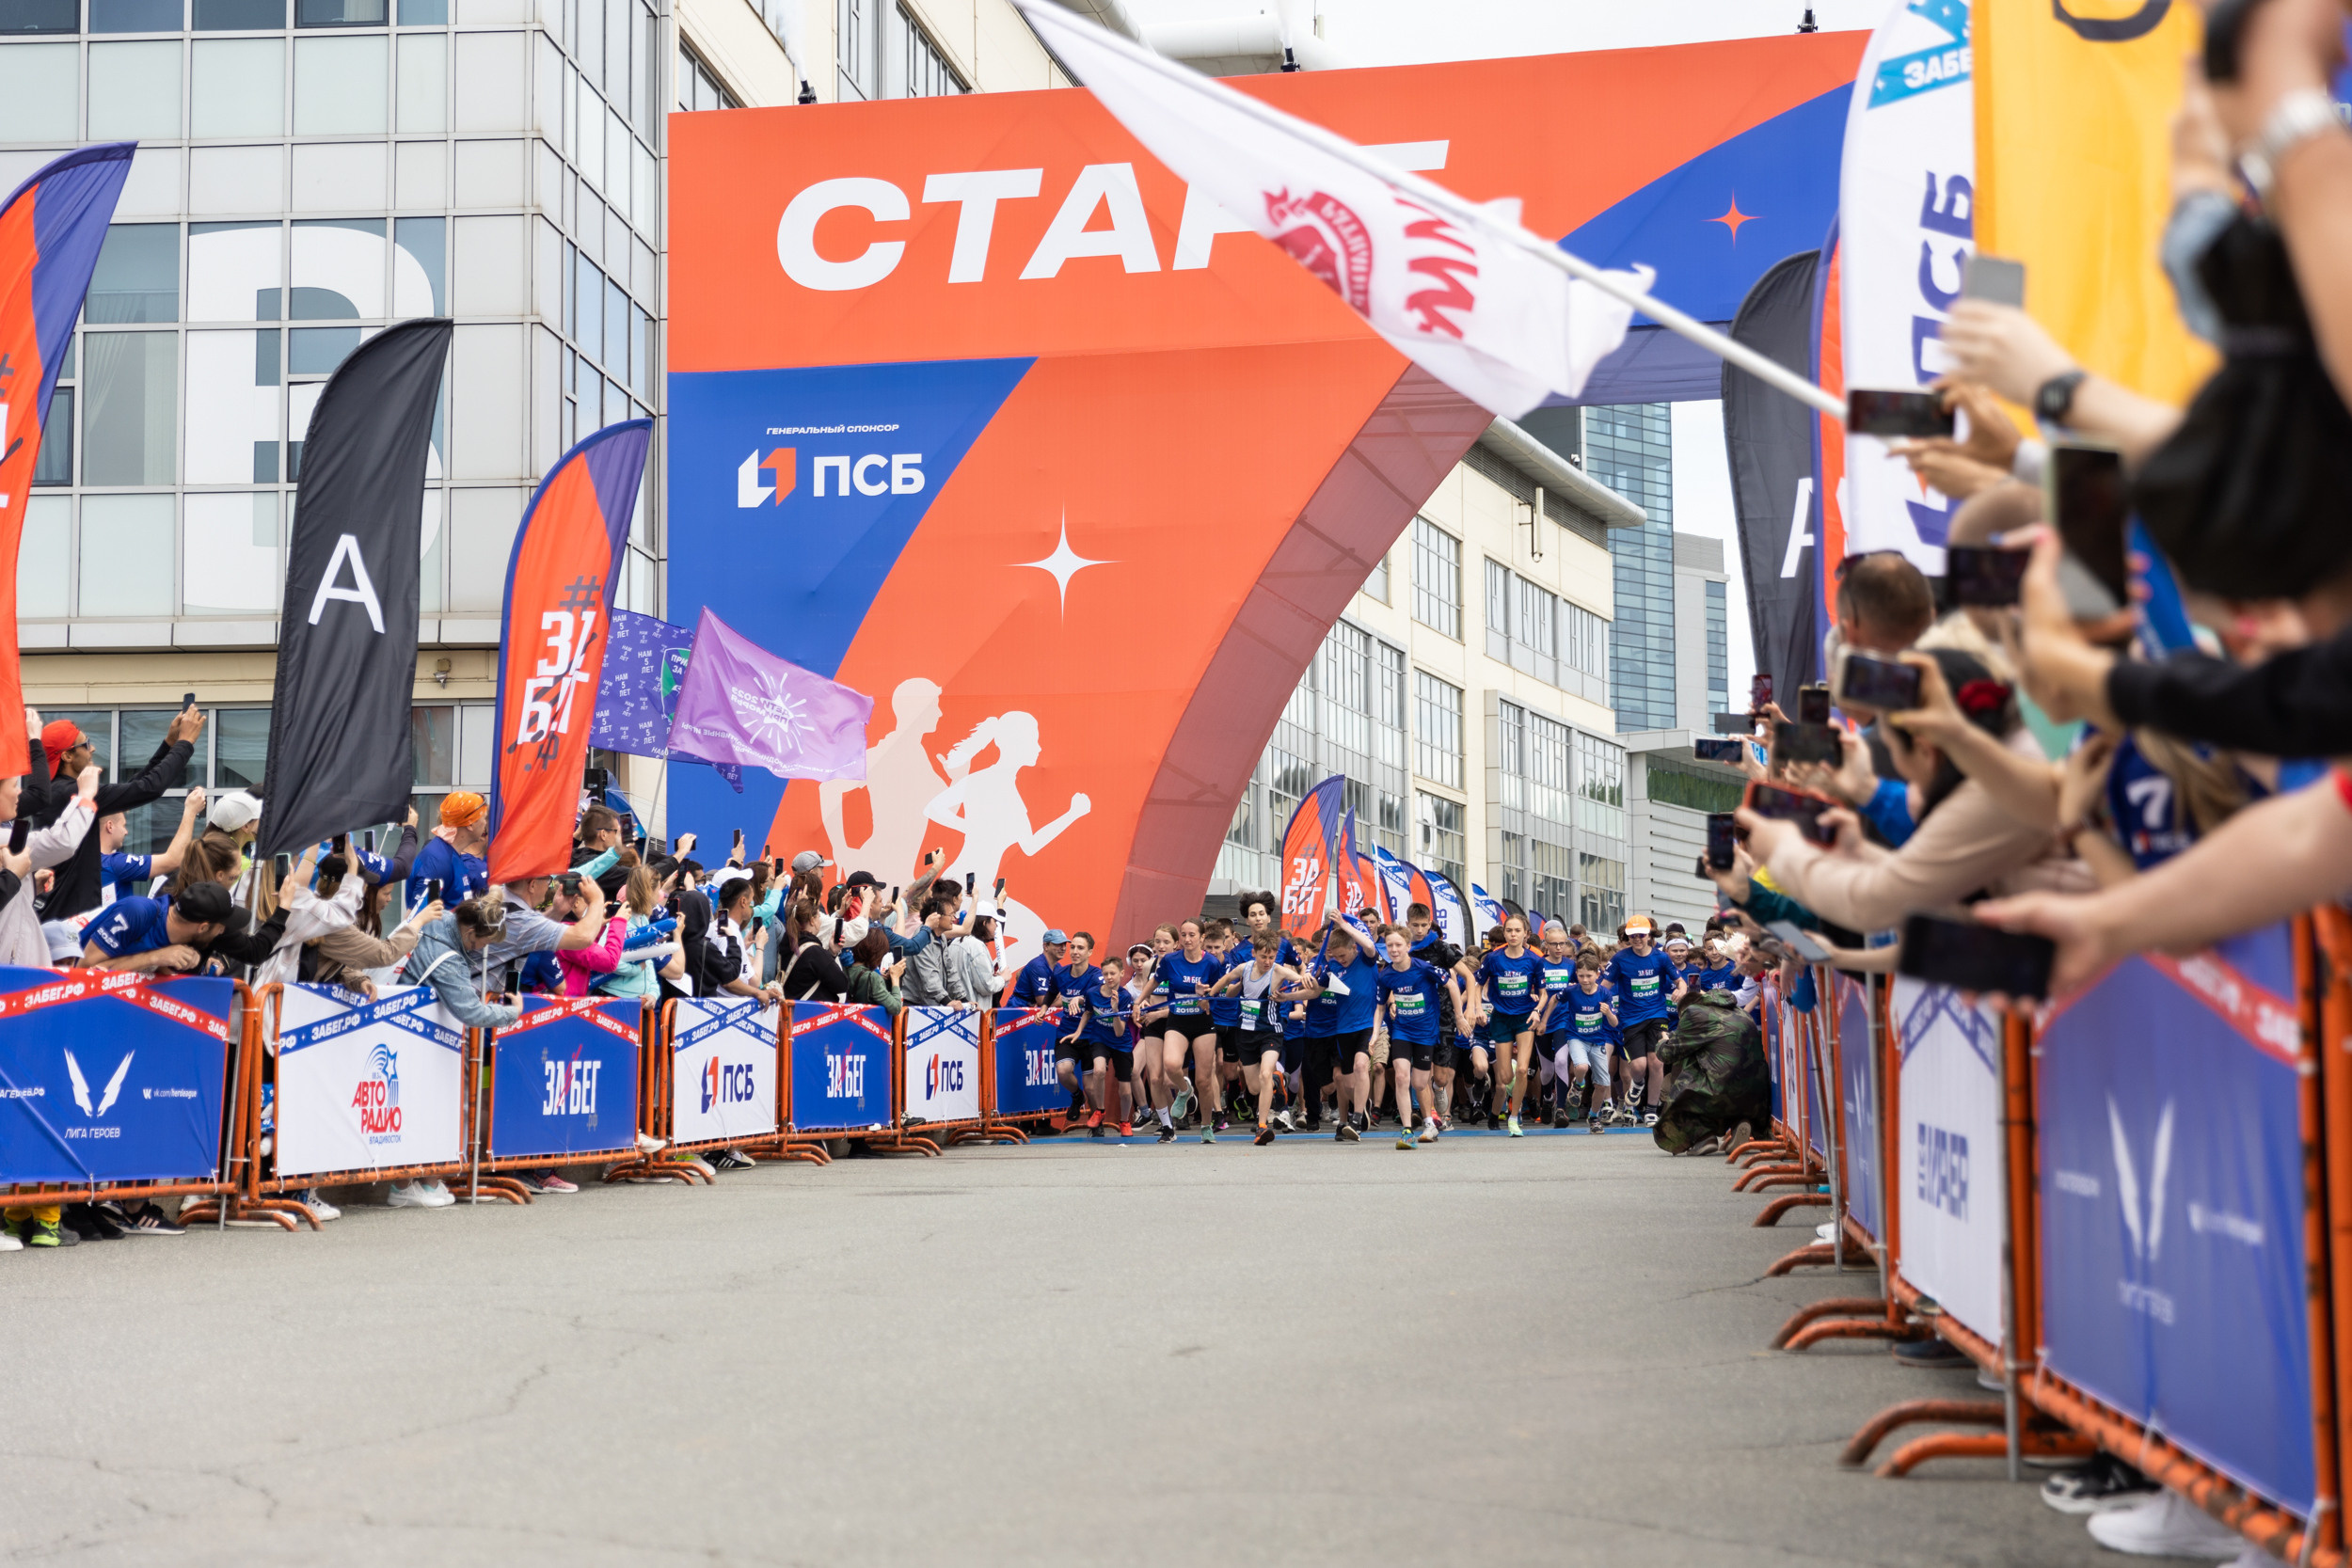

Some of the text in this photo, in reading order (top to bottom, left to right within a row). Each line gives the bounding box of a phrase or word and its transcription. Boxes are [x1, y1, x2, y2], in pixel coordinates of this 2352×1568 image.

[766, 424, 899, 436] ГЕНЕРАЛЬНЫЙ СПОНСОР
[813, 453, 926, 497] ПСБ
[2126, 775, 2171, 828] 7
[110, 912, 129, 935] 7
[97, 927, 119, 949] 2023
[24, 982, 85, 1008] ЗАБЕГ.РФ
[102, 971, 156, 990] ЗАБЕГ.РФ
[1038, 977, 1046, 987] 7
[1632, 990, 1659, 998] 20404
[150, 995, 197, 1023] ЗАБЕГ.РФ
[311, 1014, 360, 1040] ЗАБЕГ.РФ
[373, 993, 419, 1020] ЗАБЕГ.РФ
[532, 1006, 564, 1024] ЗАБЕГ.РФ
[691, 1020, 720, 1042] ЗАБЕГ.РФ
[725, 1004, 752, 1024] ЗАБЕГ.РФ
[596, 1014, 623, 1034] ЗАБЕГ.РФ
[542, 1060, 602, 1116] ЗАБЕГ
[723, 1063, 755, 1103] ПСБ
[826, 1054, 866, 1099] ЗАБЕГ
[941, 1060, 963, 1092] ПСБ
[351, 1081, 386, 1108] АВТО
[65, 1128, 120, 1139] ЛИГА ГЕРОЕВ
[361, 1106, 403, 1134] РАДИО
[369, 1133, 402, 1146] ВЛАДИВОСТОК
